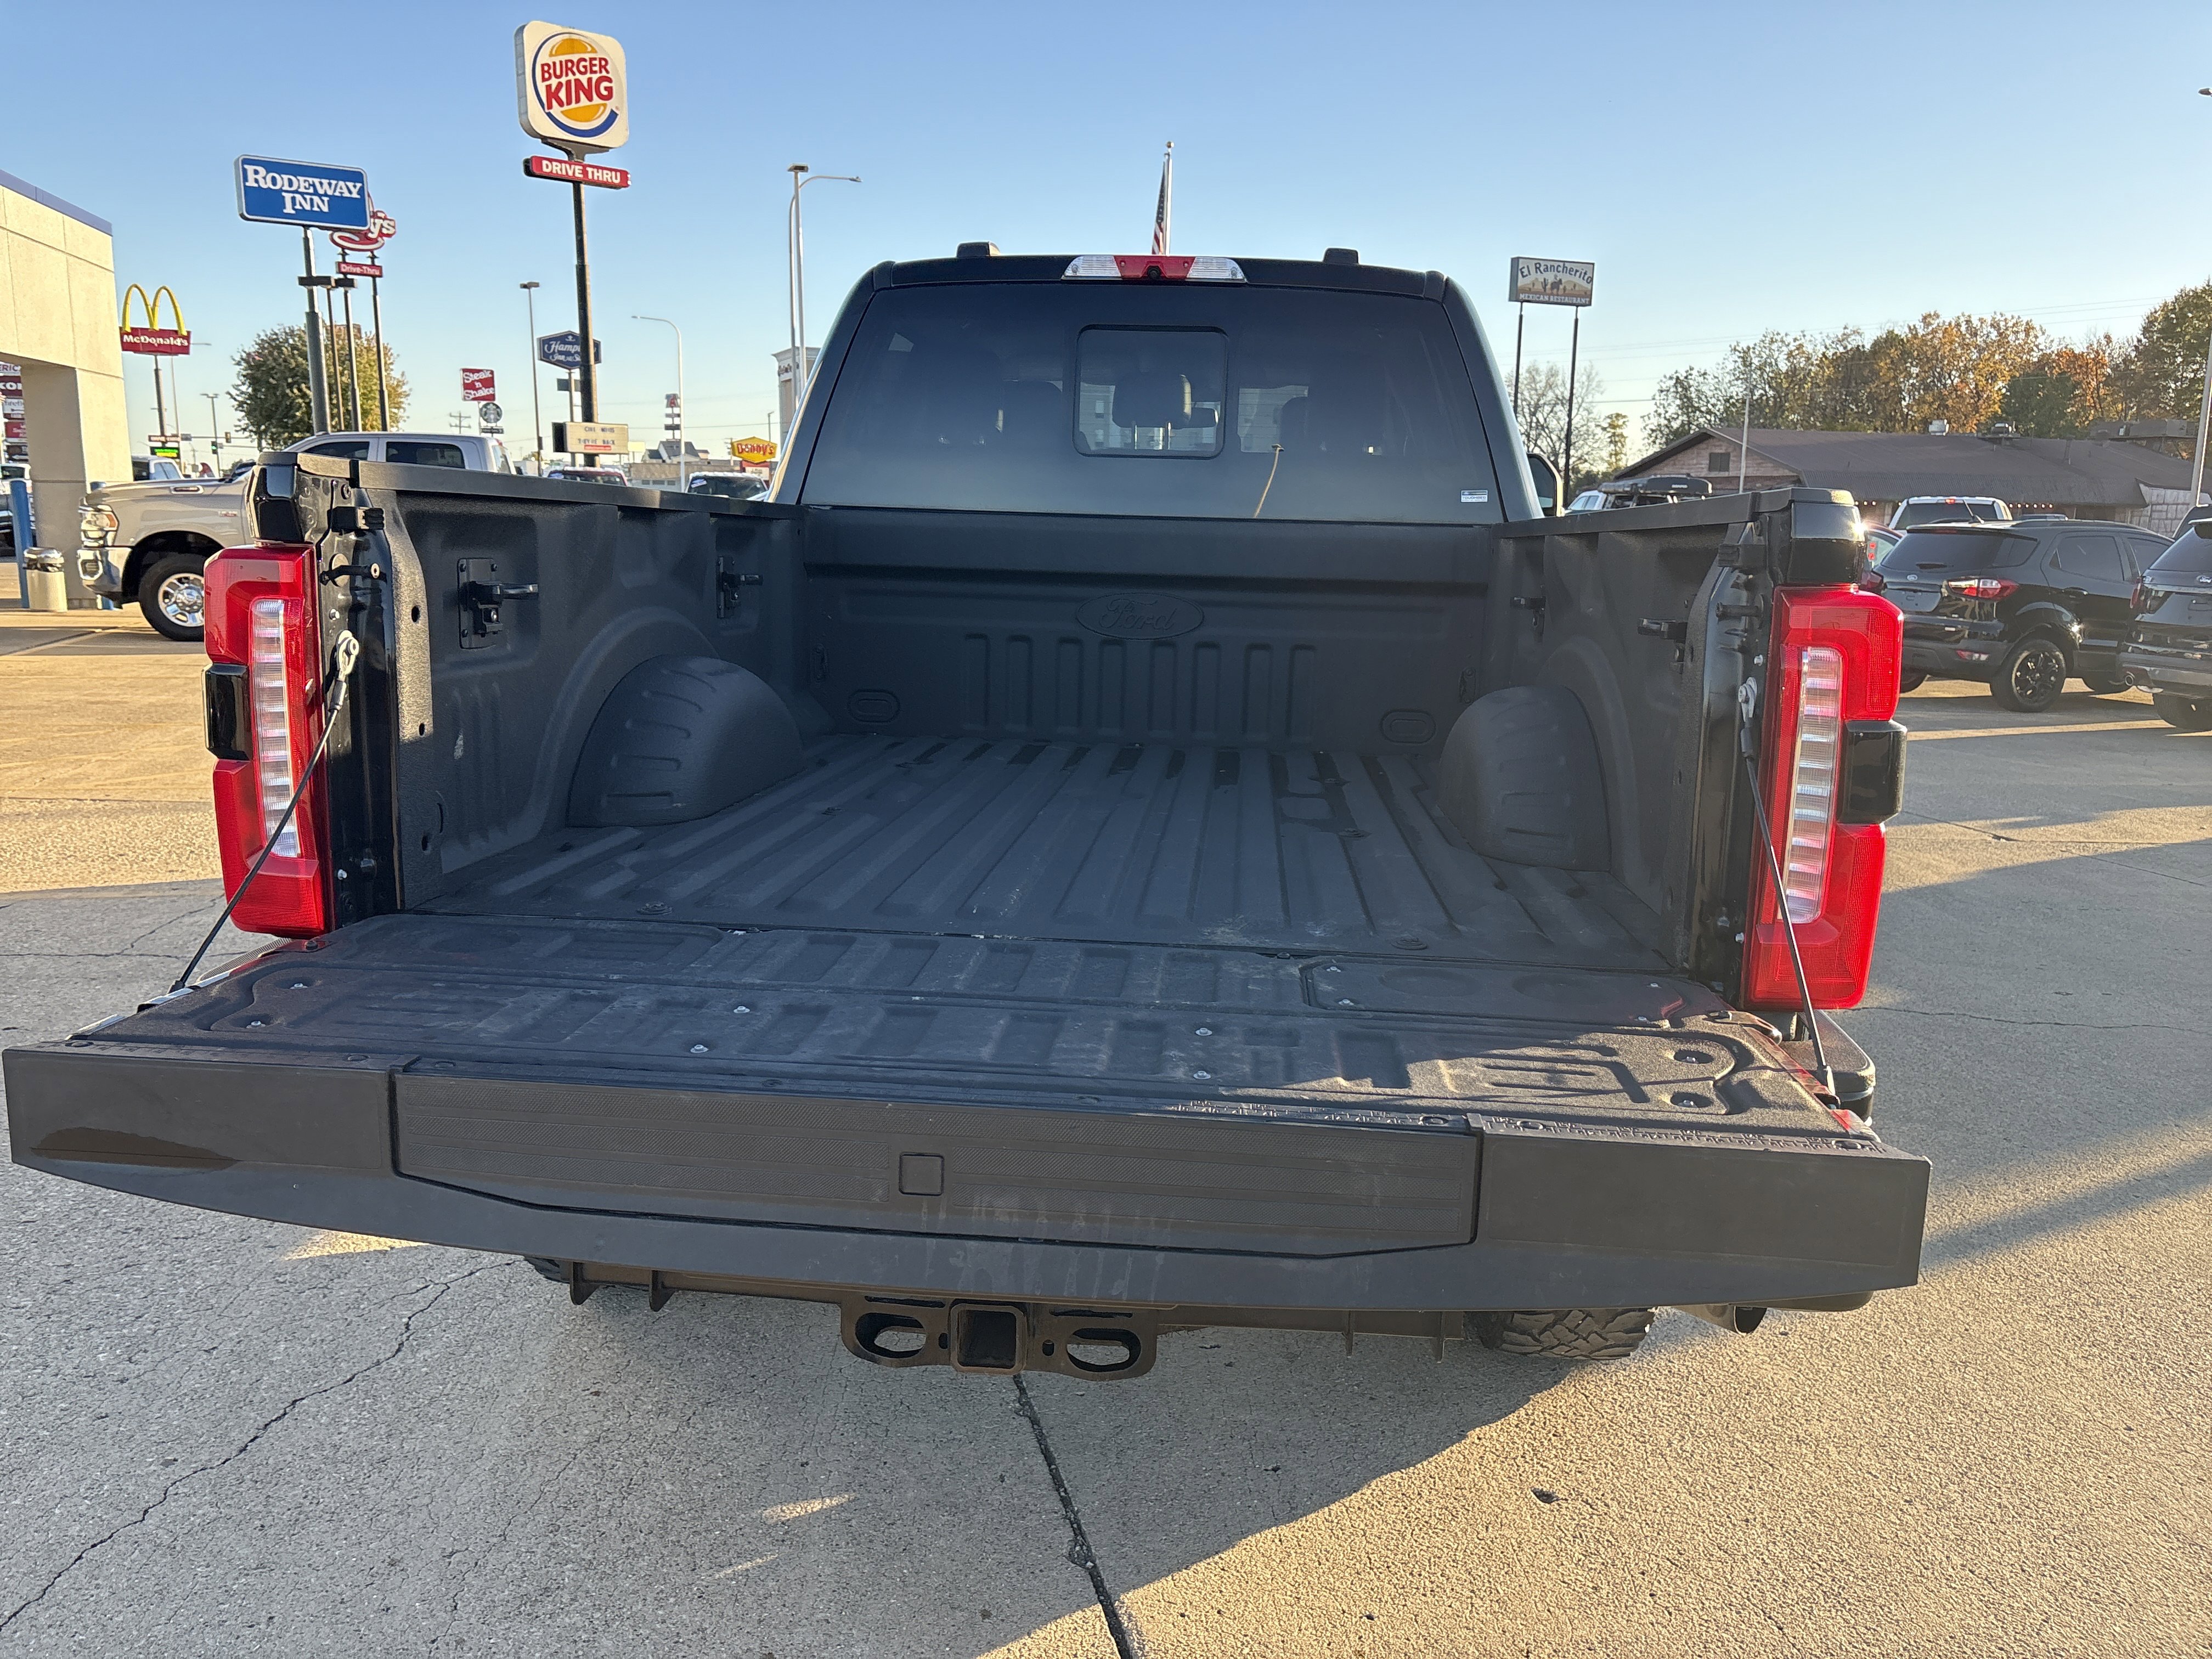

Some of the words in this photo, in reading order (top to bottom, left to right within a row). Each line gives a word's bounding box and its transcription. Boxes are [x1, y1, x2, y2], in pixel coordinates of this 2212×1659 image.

[540, 57, 610, 82] BURGER
[545, 76, 613, 110] KING
[244, 165, 362, 199] RODEWAY
[541, 160, 583, 177] DRIVE
[585, 167, 620, 183] THRU
[281, 192, 329, 215] INN
[1519, 264, 1531, 279] El
[1534, 262, 1592, 284] Rancherito
[1519, 293, 1549, 301] MEXICAN
[1549, 294, 1590, 304] RESTAURANT
[123, 334, 188, 346] McDonald's
[463, 370, 493, 383] Steak
[464, 387, 494, 400] Shake
[737, 443, 774, 456] Denny's
[1099, 598, 1178, 631] Ford
